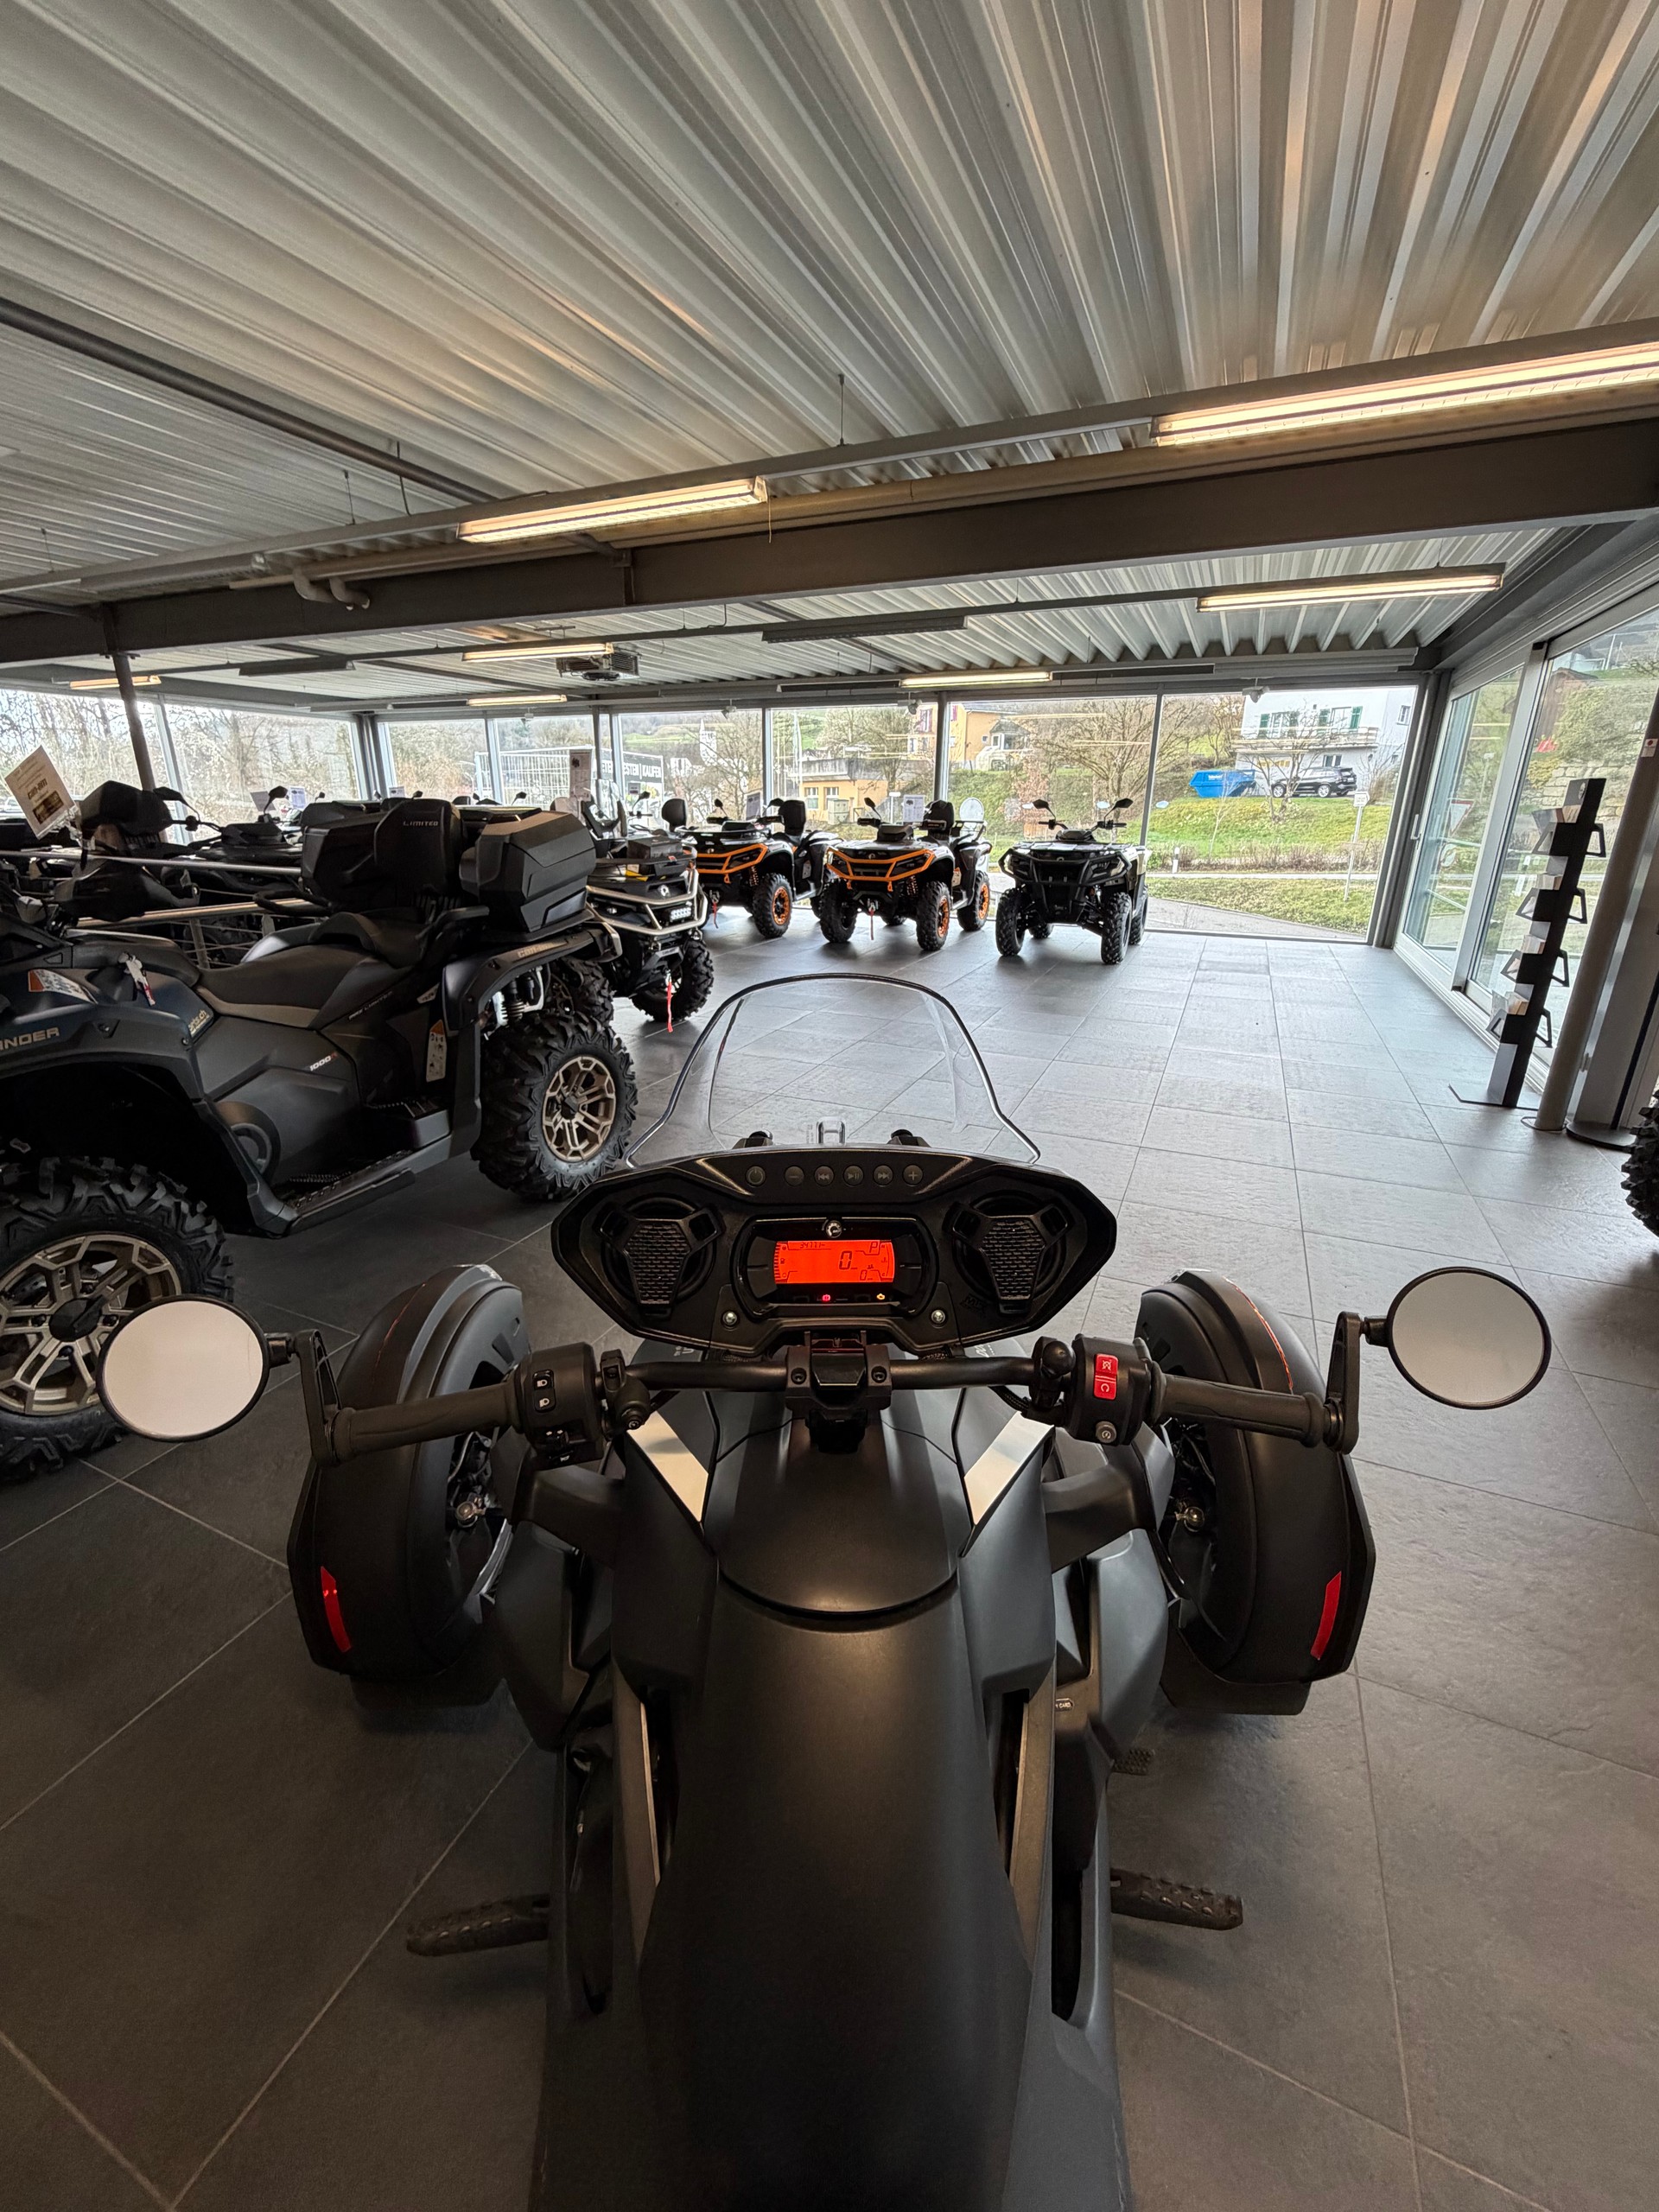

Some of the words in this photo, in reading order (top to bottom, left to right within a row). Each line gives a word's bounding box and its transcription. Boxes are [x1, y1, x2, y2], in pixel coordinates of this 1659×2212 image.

[0, 1027, 60, 1052] NDER
[869, 1241, 879, 1254] P
[838, 1250, 853, 1270] 0
[859, 1269, 868, 1281] 0
